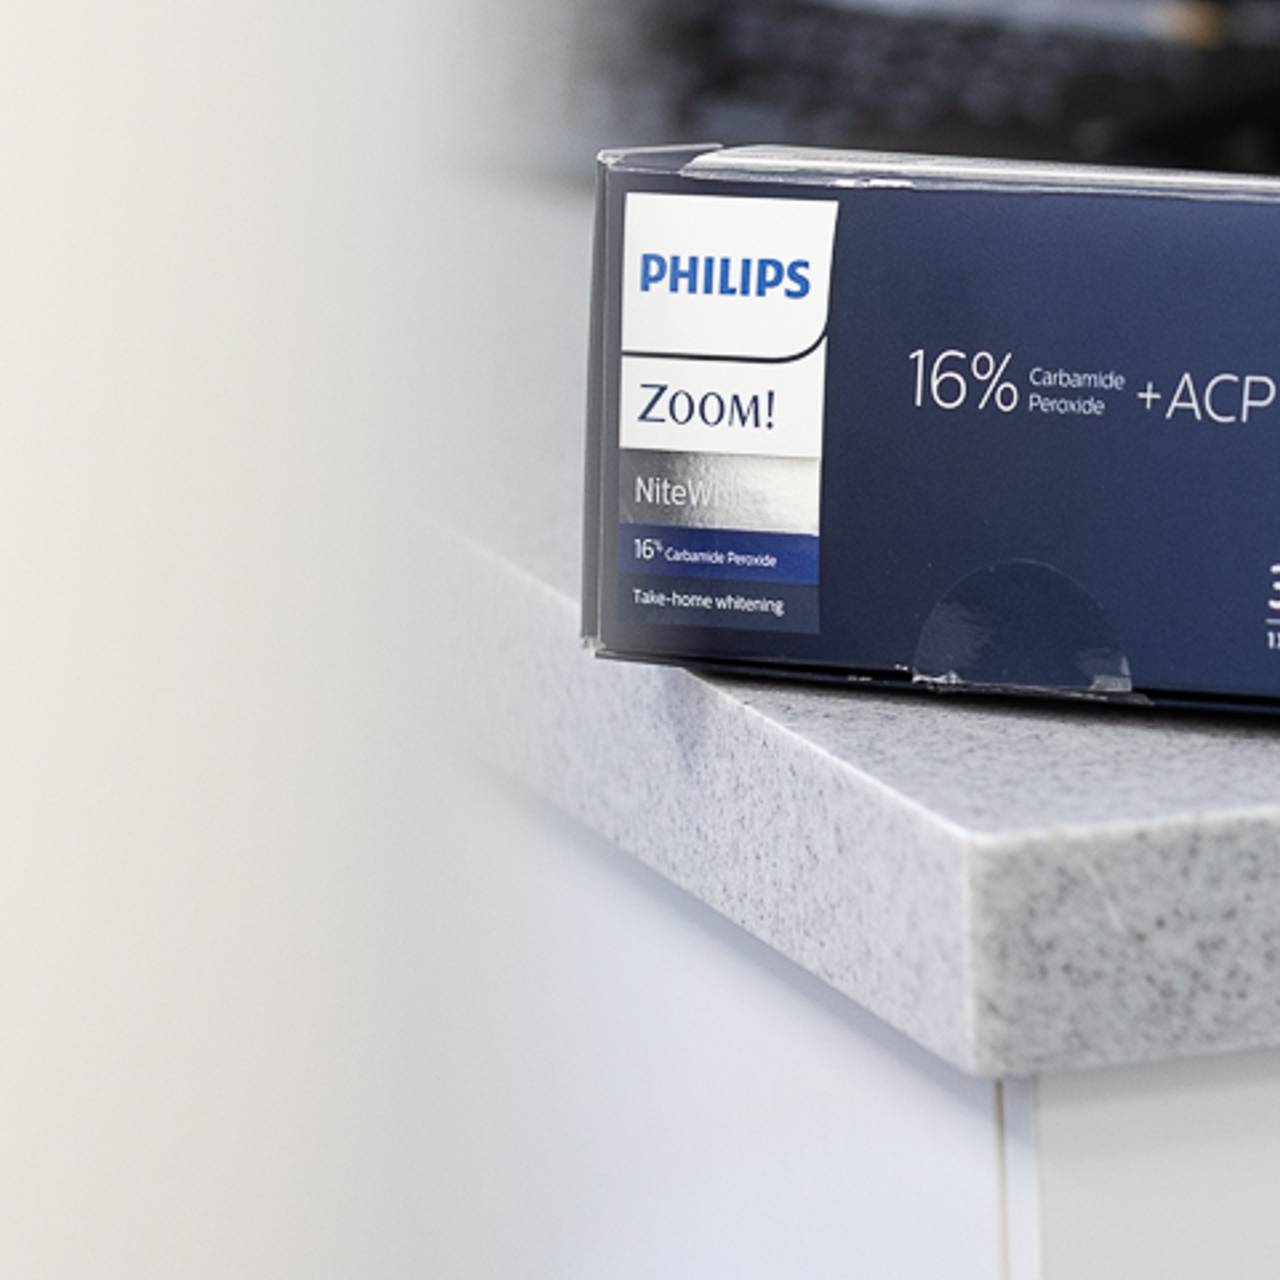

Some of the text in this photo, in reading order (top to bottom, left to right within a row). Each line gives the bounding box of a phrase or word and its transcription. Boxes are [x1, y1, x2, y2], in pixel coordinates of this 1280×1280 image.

[639, 253, 811, 299] PHILIPS
[908, 349, 1020, 413] 16%
[1028, 367, 1127, 391] Carbamide
[637, 383, 776, 429] ZOOM!
[1028, 393, 1106, 416] Peroxide
[664, 546, 724, 565] Carbamide
[726, 551, 779, 568] Peroxide
[632, 587, 786, 618] Take-home whitening
